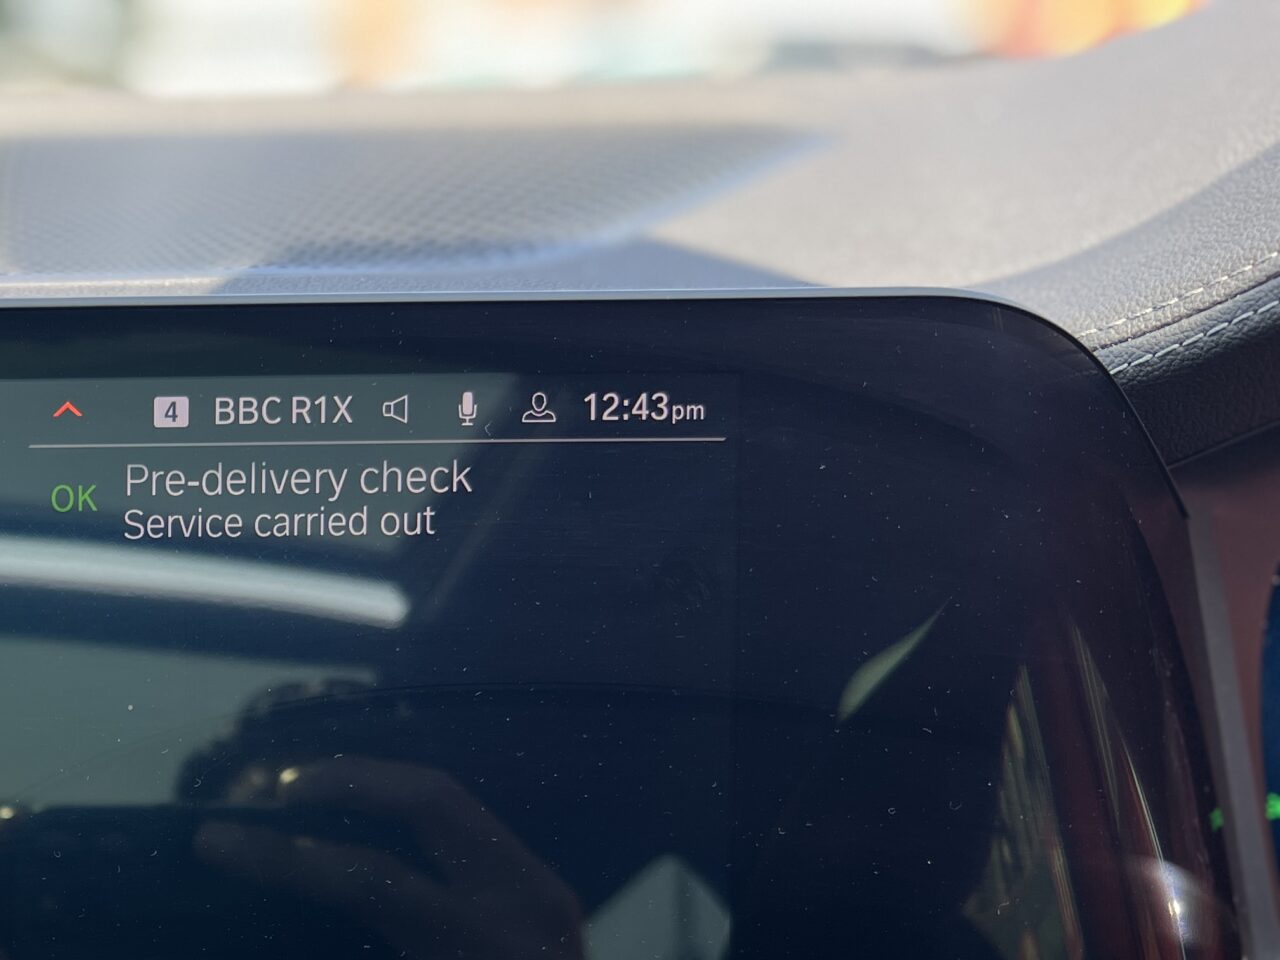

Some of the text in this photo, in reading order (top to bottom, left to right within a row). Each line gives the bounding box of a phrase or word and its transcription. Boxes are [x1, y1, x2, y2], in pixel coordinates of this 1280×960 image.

[163, 401, 179, 423] 4
[214, 396, 353, 425] BBC R1X
[584, 393, 705, 424] 12:43pm
[125, 460, 474, 501] Pre-delivery check
[51, 485, 98, 512] OK
[124, 506, 436, 539] Service carried out
